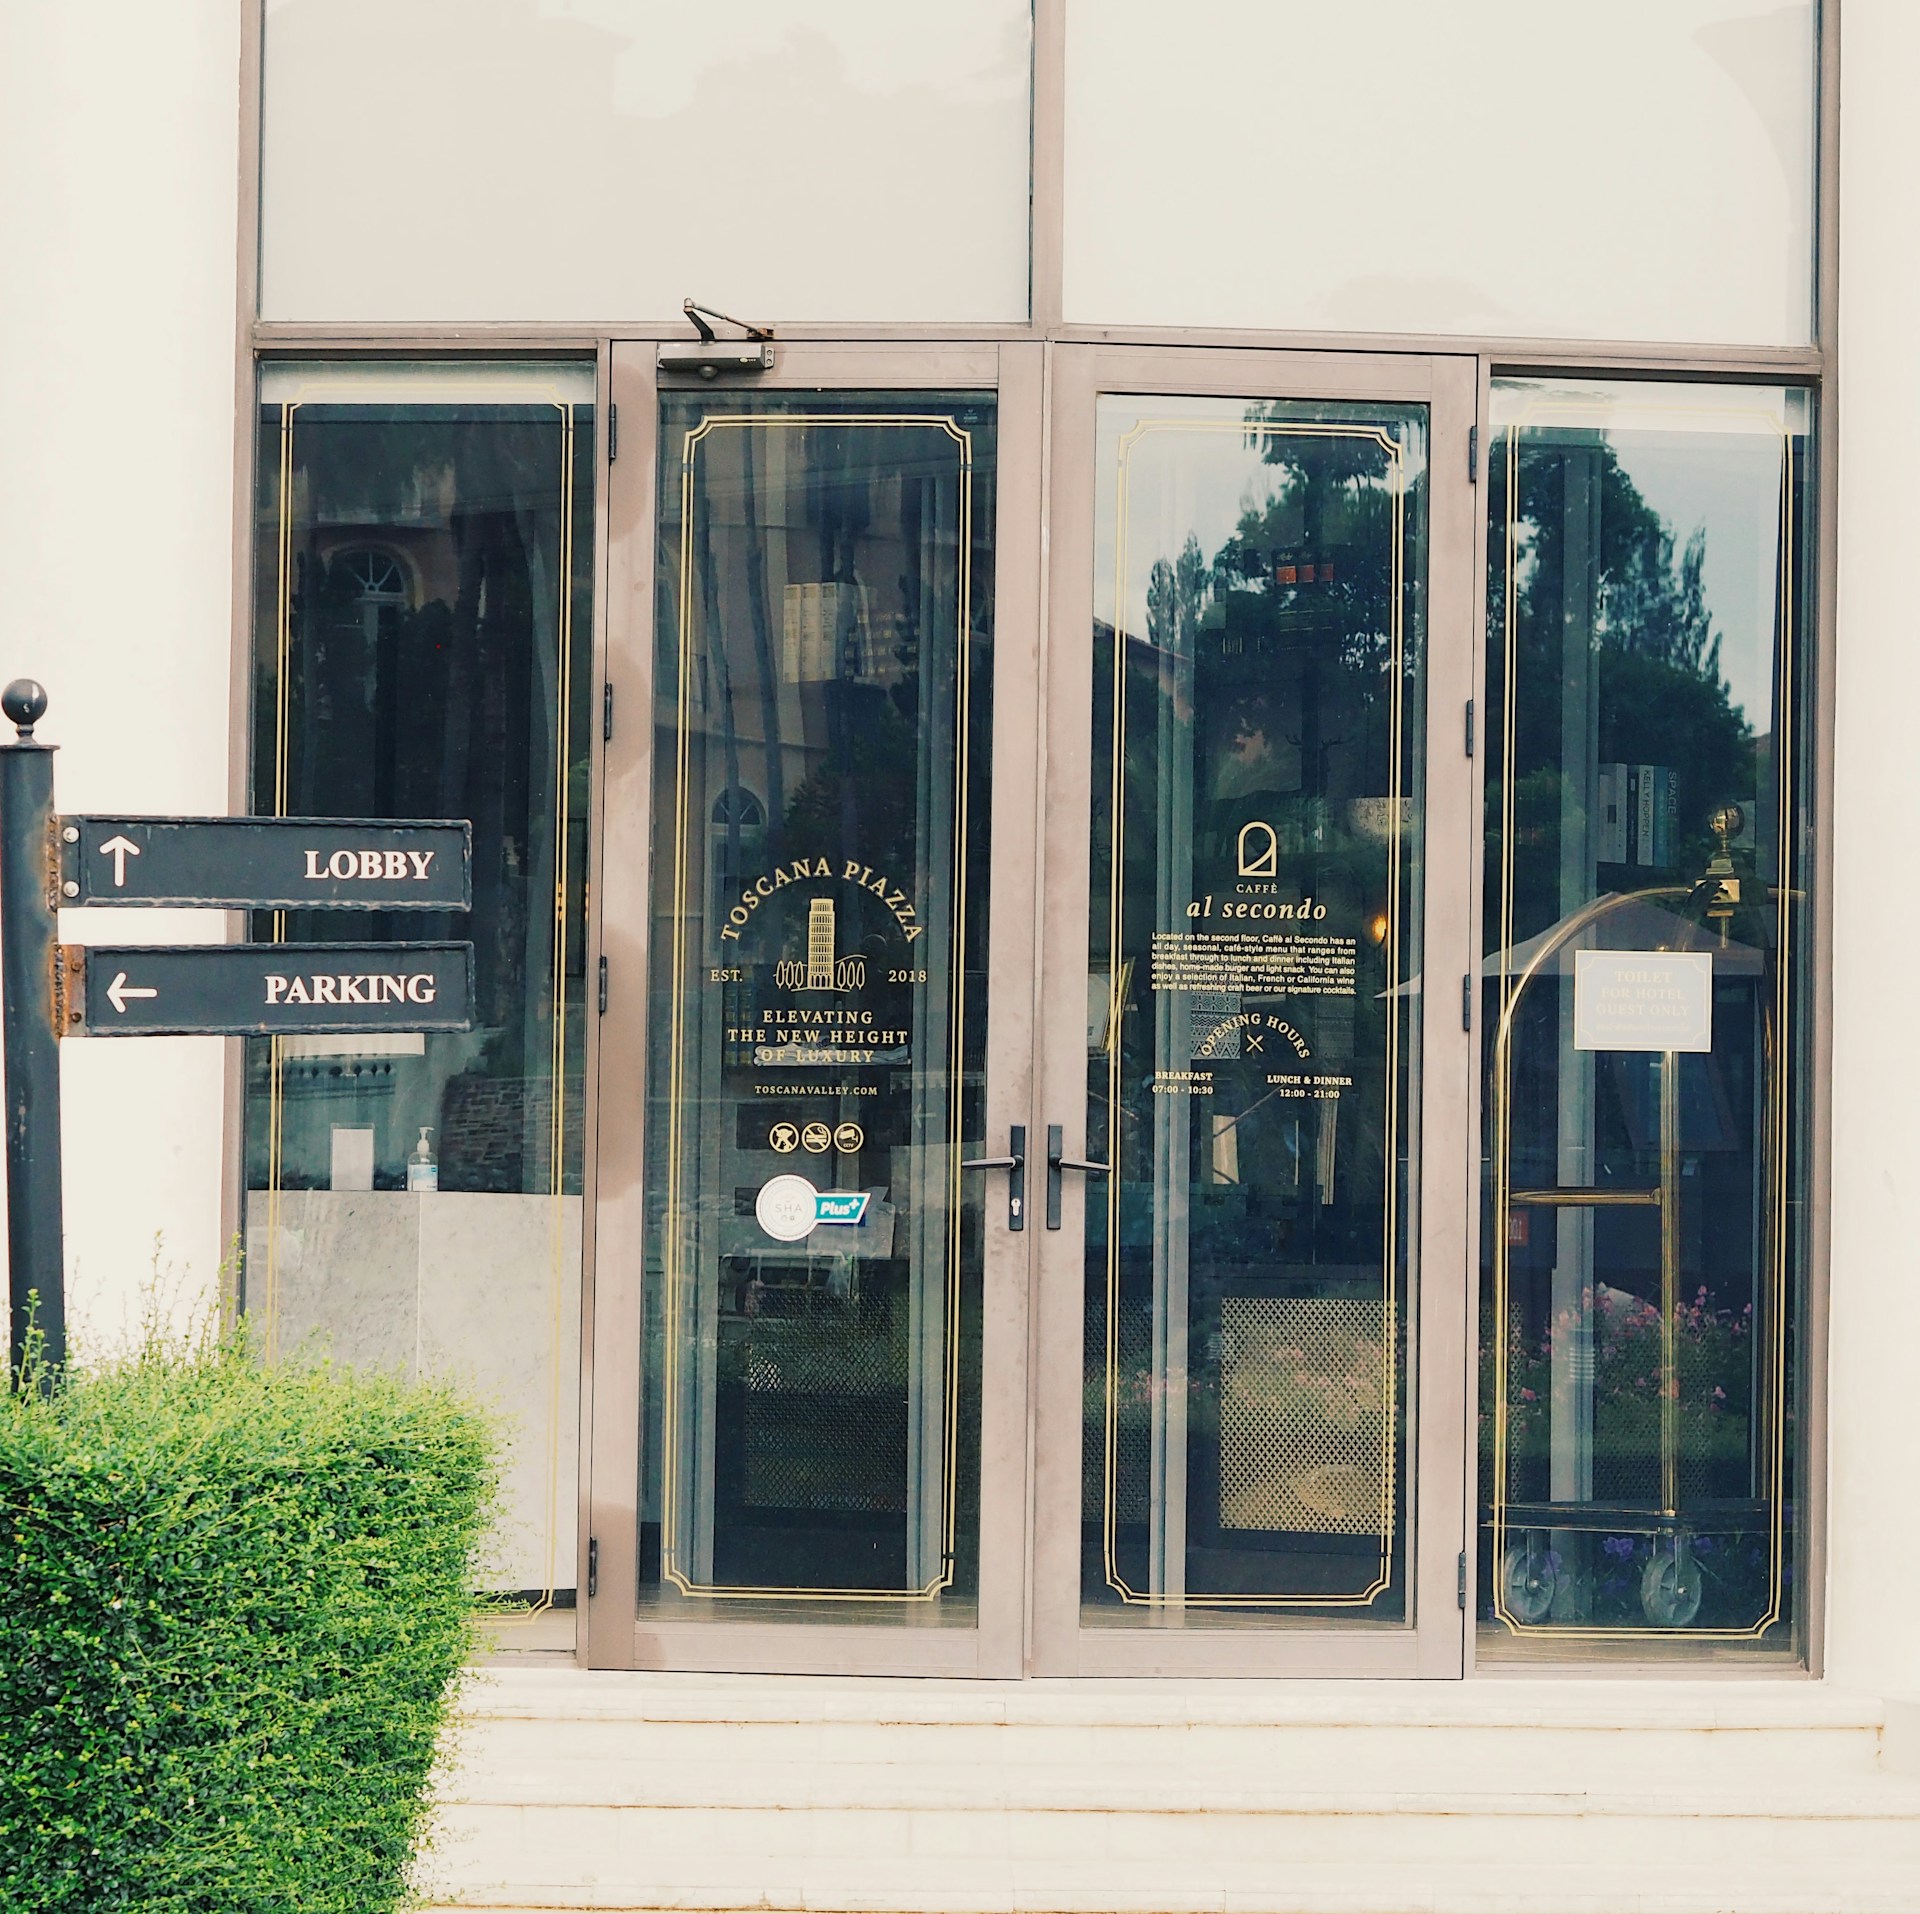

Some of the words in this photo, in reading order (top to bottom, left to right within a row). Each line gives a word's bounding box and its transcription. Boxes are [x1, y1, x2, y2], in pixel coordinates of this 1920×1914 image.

[1668, 771, 1677, 814] SPACE
[304, 851, 435, 880] LOBBY
[1236, 882, 1278, 894] CAFFÈ
[720, 857, 832, 942] TOSCANA
[842, 860, 923, 943] PIAZZA
[1186, 895, 1213, 918] al
[1222, 898, 1327, 920] secondo
[1152, 932, 1182, 940] Located
[1197, 933, 1209, 941] the
[1211, 934, 1239, 942] second
[1241, 934, 1260, 944] floor,
[1285, 936, 1292, 944] al
[1294, 936, 1328, 944] Secondo
[1330, 937, 1344, 945] has
[1346, 938, 1356, 946] an
[1152, 942, 1161, 950] all
[1183, 944, 1222, 952] seasonal,
[1290, 946, 1305, 954] that
[1308, 947, 1335, 956] ranges
[1337, 947, 1355, 955] from
[1152, 952, 1188, 960] breakfast
[1189, 953, 1218, 962] through
[1230, 954, 1251, 962] lunch
[1253, 954, 1268, 962] and
[1270, 955, 1294, 963] dinner
[1295, 956, 1330, 965] including
[1332, 956, 1355, 965] Italian
[710, 969, 743, 982] EST.
[888, 969, 927, 983] 2018
[1180, 963, 1223, 971] home-made
[1225, 964, 1249, 973] burger
[1266, 965, 1282, 974] light
[1308, 966, 1323, 974] You
[1339, 967, 1355, 975] also
[1151, 972, 1173, 982] enjoy
[1182, 973, 1218, 981] selection
[1219, 973, 1228, 981] of
[1257, 974, 1286, 982] French
[1297, 976, 1334, 984] California
[1614, 970, 1672, 984] TOILET
[264, 974, 436, 1005] PARKING
[1162, 982, 1177, 990] well
[1189, 983, 1226, 992] refreshing
[1227, 984, 1244, 992] craft
[1246, 984, 1263, 992] beer
[1287, 985, 1321, 995] signature
[1601, 987, 1632, 1000] FOR
[1636, 988, 1686, 1000] HOTEL
[762, 1010, 874, 1024] ELEVATING
[1596, 1004, 1645, 1016] GUEST
[1649, 1004, 1690, 1018] ONLY
[728, 1028, 766, 1042] THE
[776, 1029, 820, 1043] NEW
[830, 1030, 908, 1044] HEIGHT
[1200, 1013, 1261, 1056] OPENING
[1266, 1015, 1310, 1060] HOURS
[760, 1048, 785, 1062] OF
[796, 1049, 874, 1063] LUXURY
[1155, 1072, 1213, 1081] BREAKFAST
[1267, 1074, 1301, 1084] LUNCH
[1304, 1076, 1311, 1084] &
[1313, 1076, 1352, 1086] DINNER
[754, 1085, 878, 1096] TOSCANAVALLEY.COM
[1152, 1085, 1179, 1094] 07:00
[1188, 1086, 1214, 1094] 10:30
[1280, 1089, 1305, 1098] 12:00
[1314, 1090, 1340, 1099] 21:00
[775, 1204, 802, 1213] SHA
